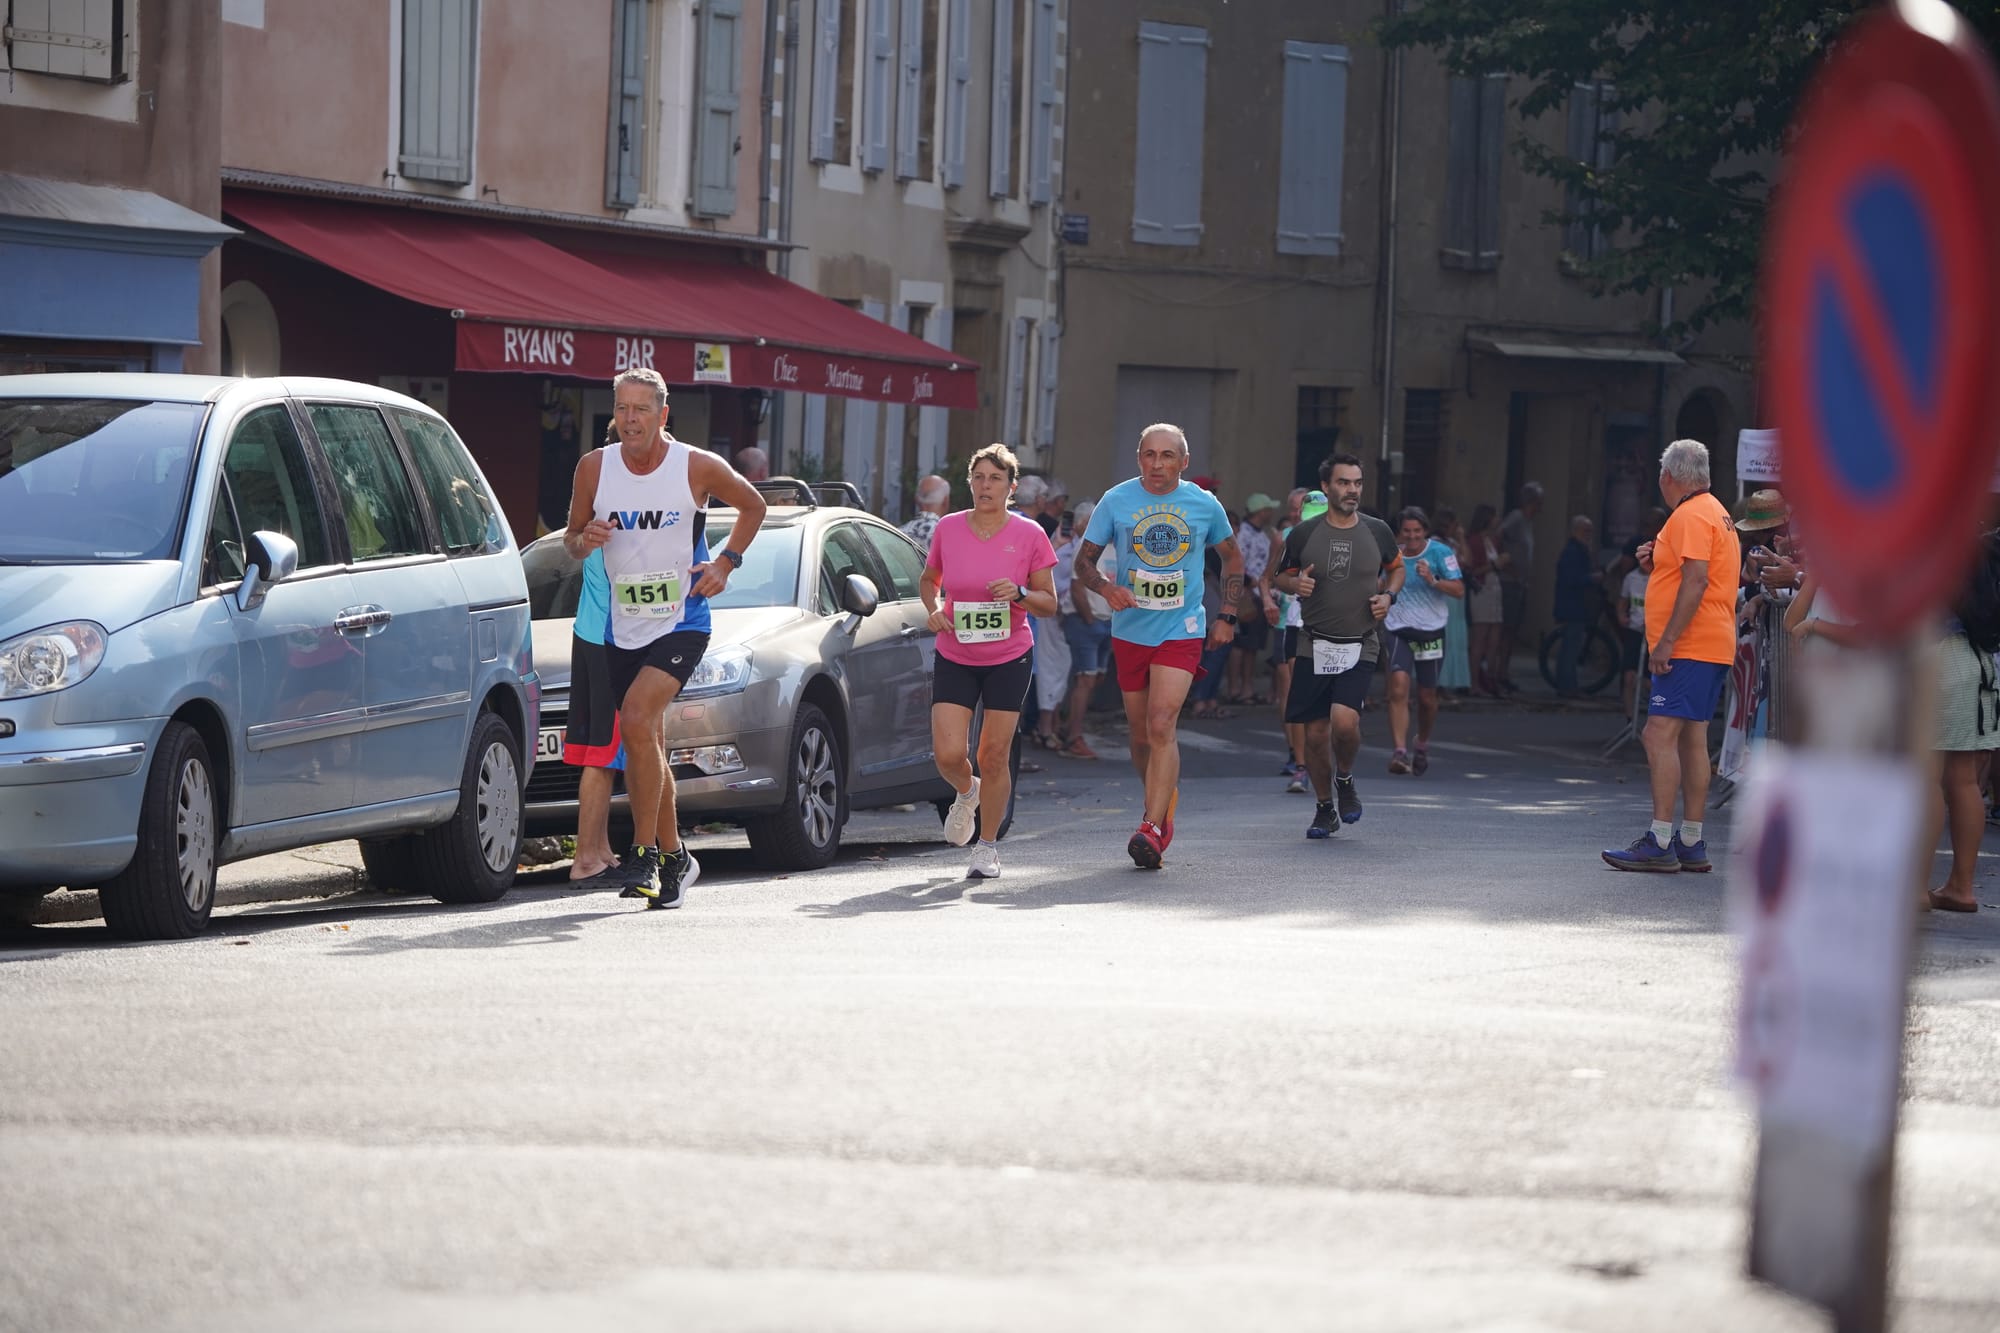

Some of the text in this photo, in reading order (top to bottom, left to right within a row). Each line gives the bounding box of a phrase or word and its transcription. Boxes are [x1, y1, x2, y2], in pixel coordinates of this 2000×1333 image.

[504, 327, 655, 370] RYAN'S BAR
[774, 354, 798, 383] Chez
[825, 363, 864, 391] Martine
[882, 375, 892, 394] et
[608, 510, 663, 530] AVW
[626, 583, 668, 603] 151
[1142, 582, 1178, 598] 109
[962, 612, 1002, 629] 155
